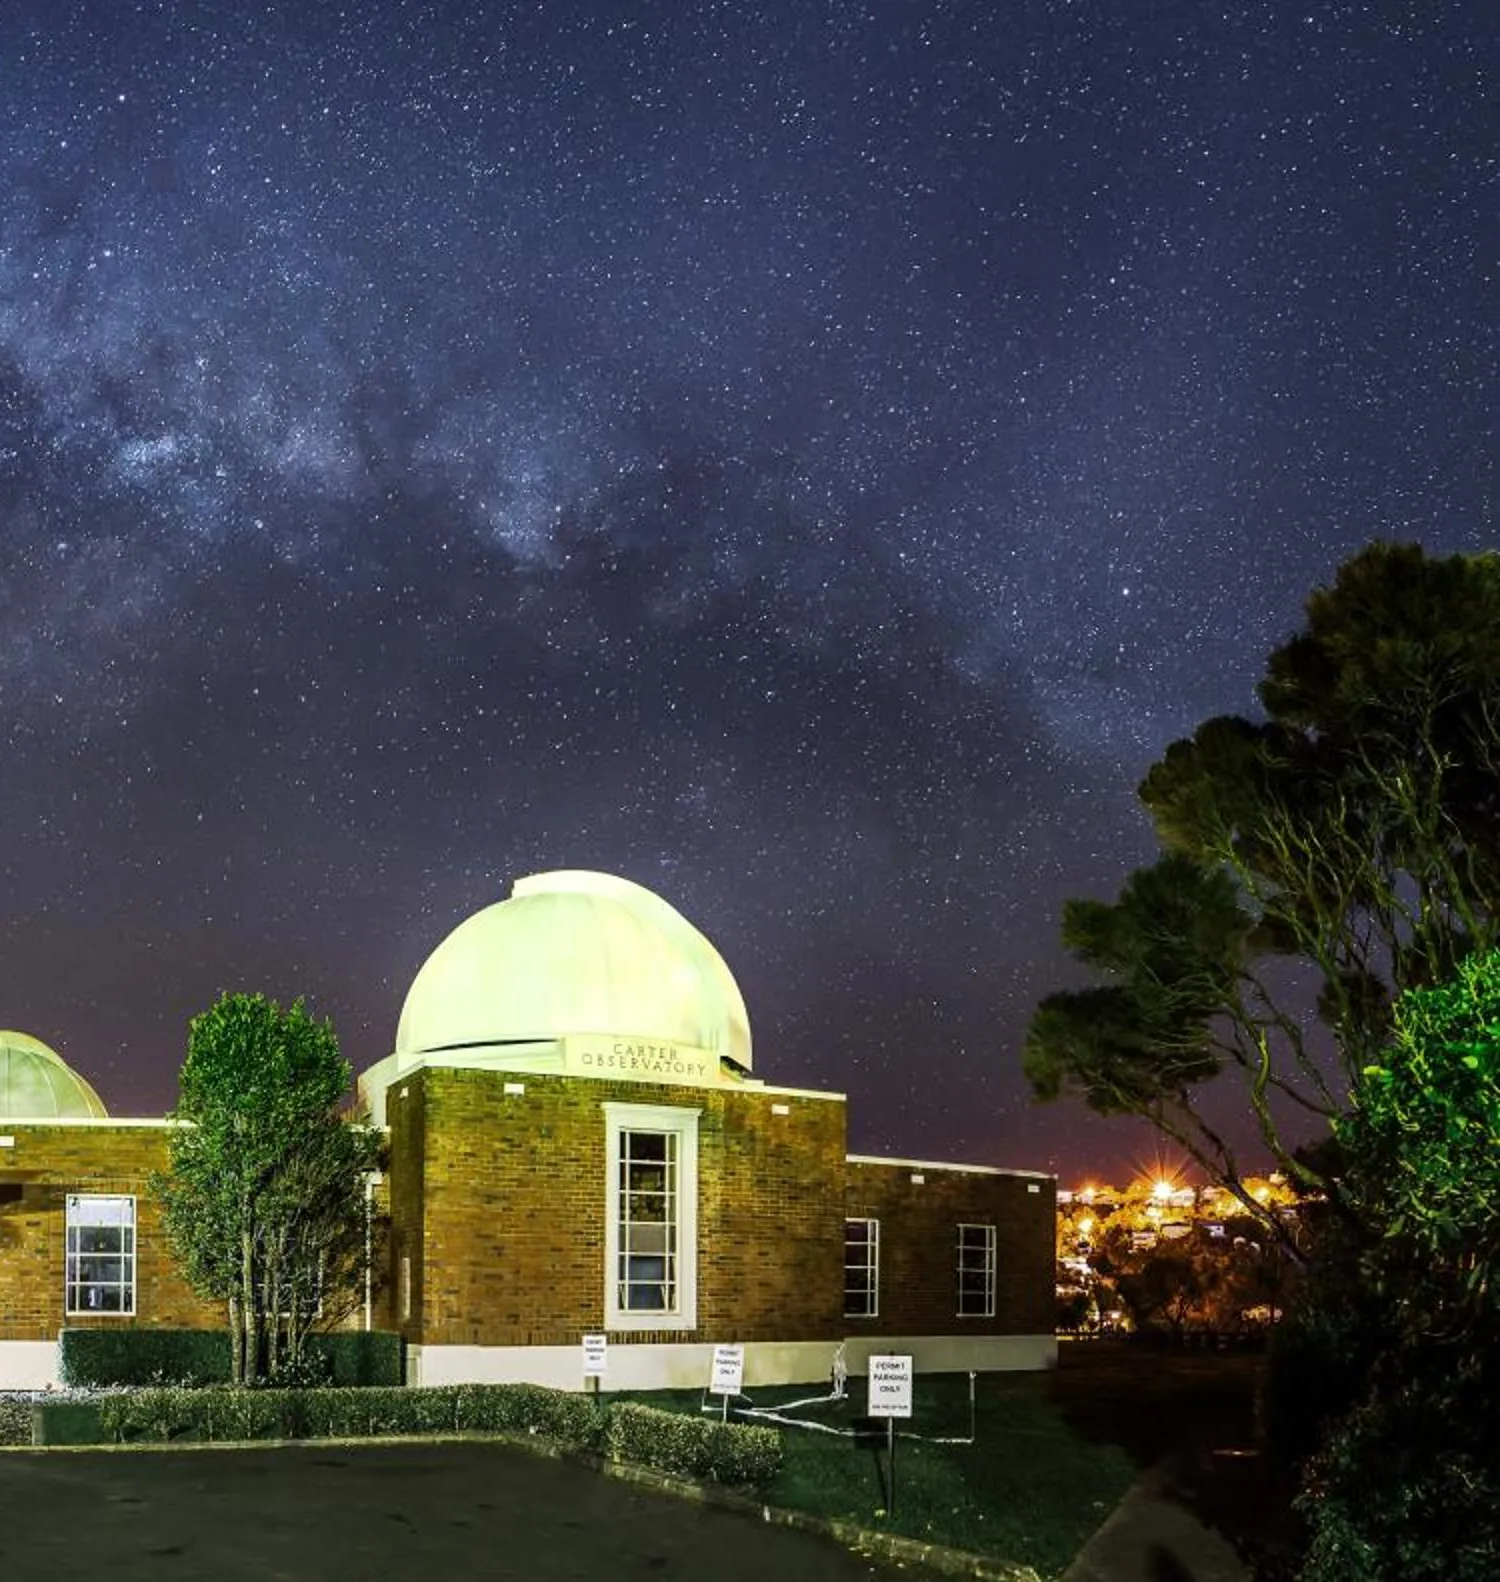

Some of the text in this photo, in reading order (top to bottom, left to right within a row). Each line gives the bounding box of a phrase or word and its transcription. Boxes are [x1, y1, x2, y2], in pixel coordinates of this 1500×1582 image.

[613, 1043, 678, 1060] CARTER
[581, 1053, 707, 1077] OBSERVATORY
[873, 1373, 909, 1382] PARKING
